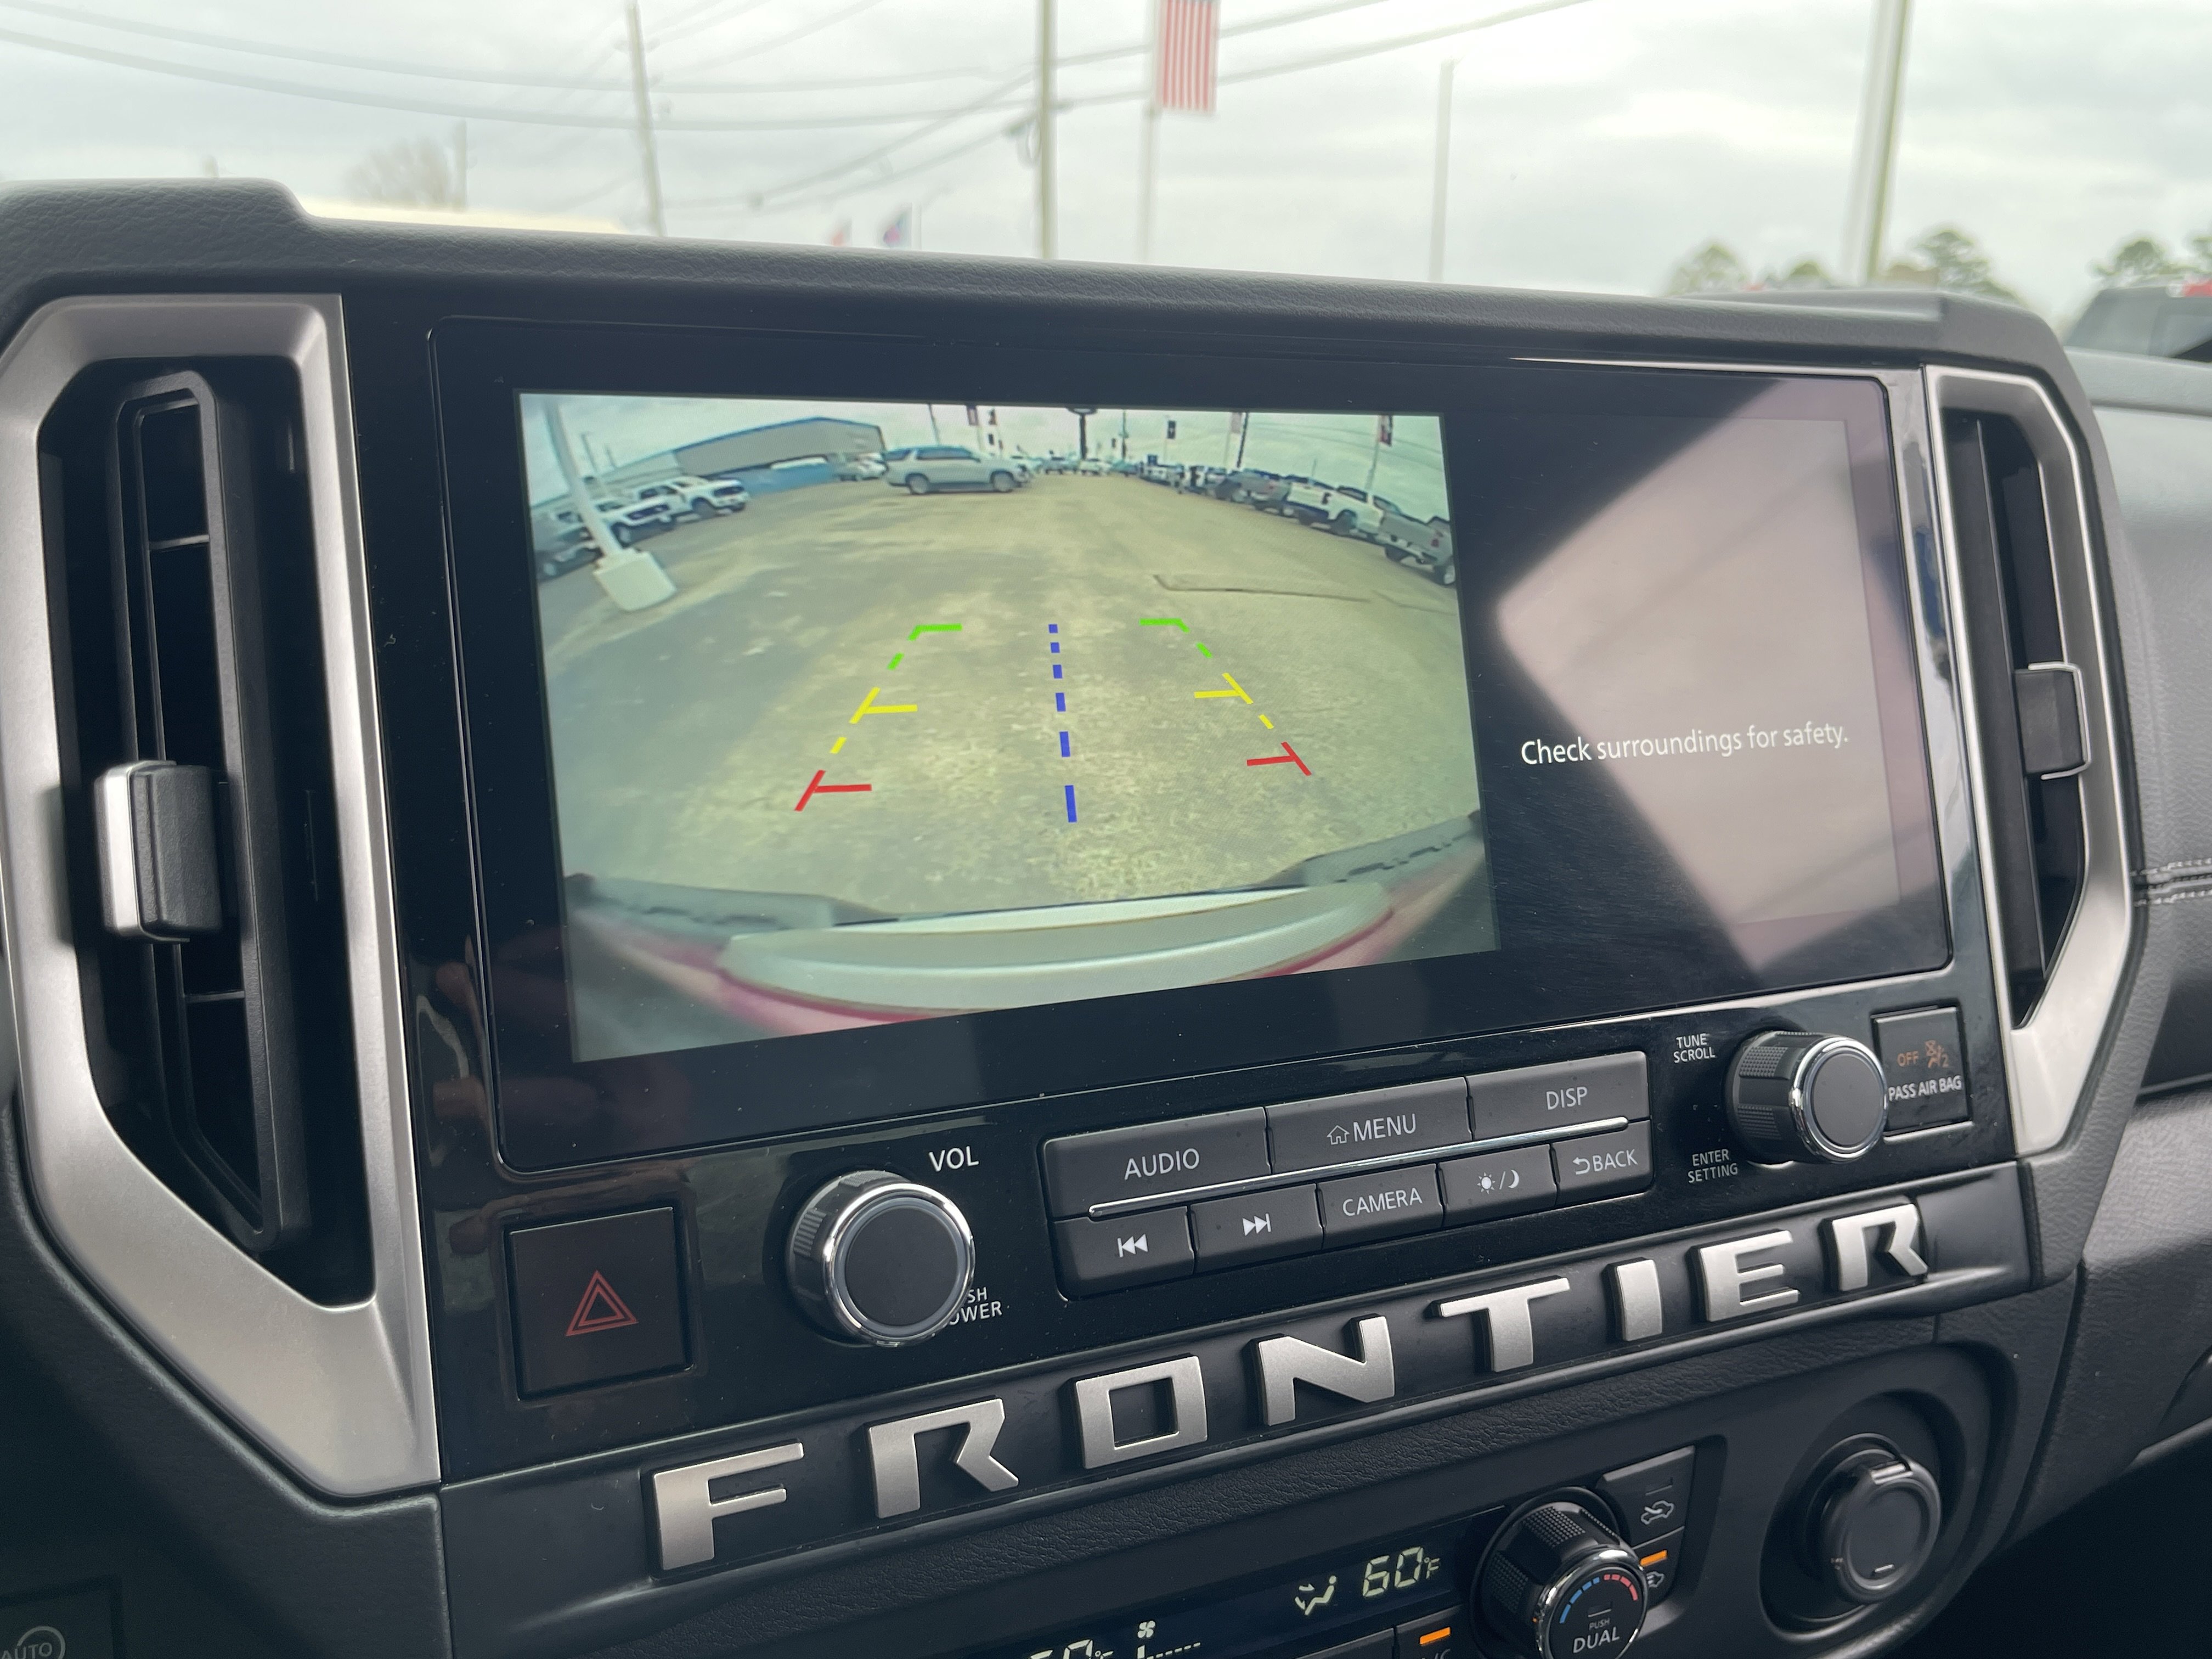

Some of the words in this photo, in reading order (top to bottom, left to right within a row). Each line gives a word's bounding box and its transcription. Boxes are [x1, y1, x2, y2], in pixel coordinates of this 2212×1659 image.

[1521, 736, 1592, 765] Check
[1596, 729, 1742, 757] surroundings
[1747, 724, 1778, 749] for
[1782, 720, 1849, 749] safety.
[1675, 1032, 1707, 1049] TUNE
[1673, 1046, 1716, 1064] SCROLL
[1897, 1050, 1919, 1068] OFF
[1544, 1085, 1589, 1111] DISP
[1888, 1083, 1917, 1102] PASS
[1918, 1079, 1938, 1097] AIR
[1938, 1075, 1962, 1093] BAG
[1352, 1113, 1418, 1143] MENU
[928, 1146, 979, 1172] VOL
[1124, 1147, 1200, 1181] AUDIO
[1592, 1148, 1638, 1174] BACK
[1692, 1148, 1730, 1167] ENTER
[1688, 1163, 1738, 1183] SETTING
[1341, 1187, 1423, 1218] CAMERA
[967, 1286, 988, 1304] SH
[653, 1203, 1929, 1571] FRONTIER
[1588, 1617, 1611, 1631] PUSH
[1572, 1626, 1620, 1654] DUAL
